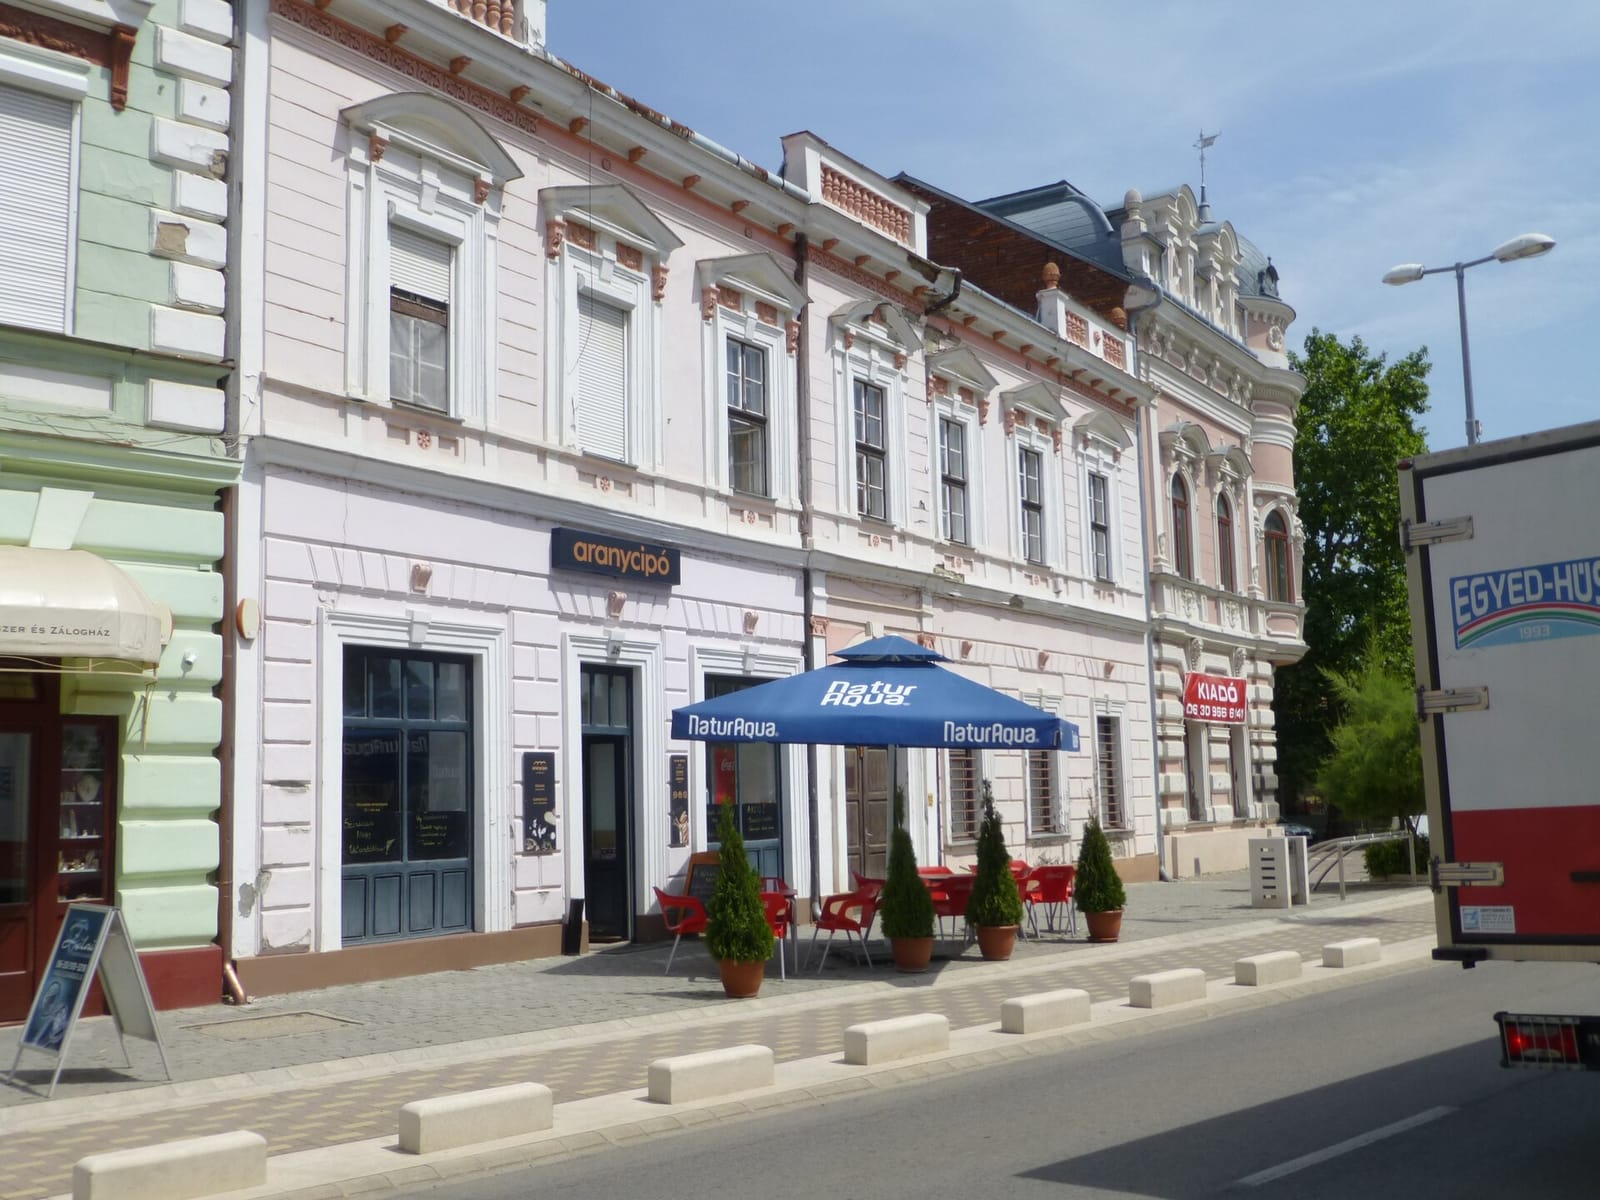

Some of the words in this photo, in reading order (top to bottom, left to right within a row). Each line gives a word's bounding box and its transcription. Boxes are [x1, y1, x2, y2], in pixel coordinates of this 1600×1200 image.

[573, 541, 671, 577] aranycipó
[0, 625, 26, 634] ZER
[1520, 624, 1551, 639] 1993
[1197, 681, 1238, 703] KIADÓ
[1186, 703, 1198, 715] 06
[1200, 704, 1211, 716] 30
[688, 714, 776, 740] NaturAqua
[943, 720, 1037, 745] NaturAqua
